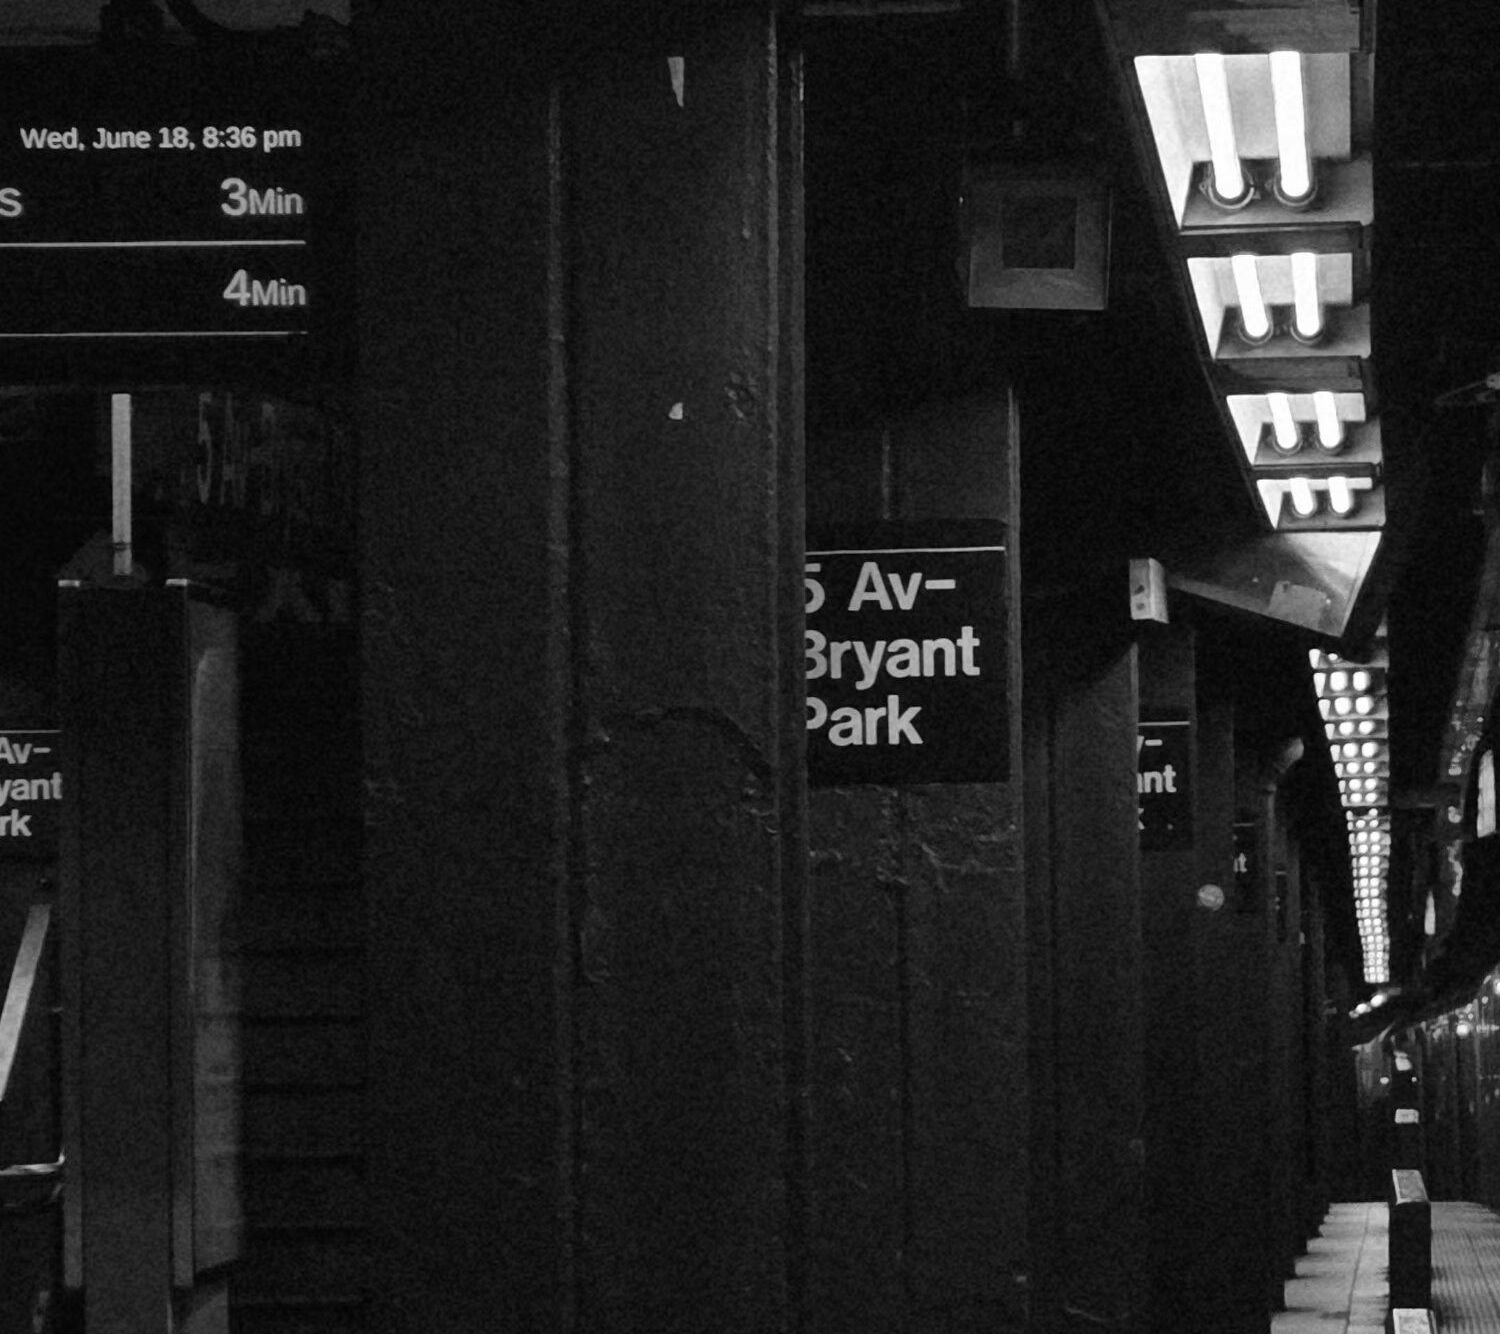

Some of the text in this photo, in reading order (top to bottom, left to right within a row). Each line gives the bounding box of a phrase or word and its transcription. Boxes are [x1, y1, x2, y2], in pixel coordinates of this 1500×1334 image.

[20, 125, 302, 154] Wed, June 18, 8:36 pm
[847, 561, 957, 612] Av-
[804, 625, 982, 692] Bryant
